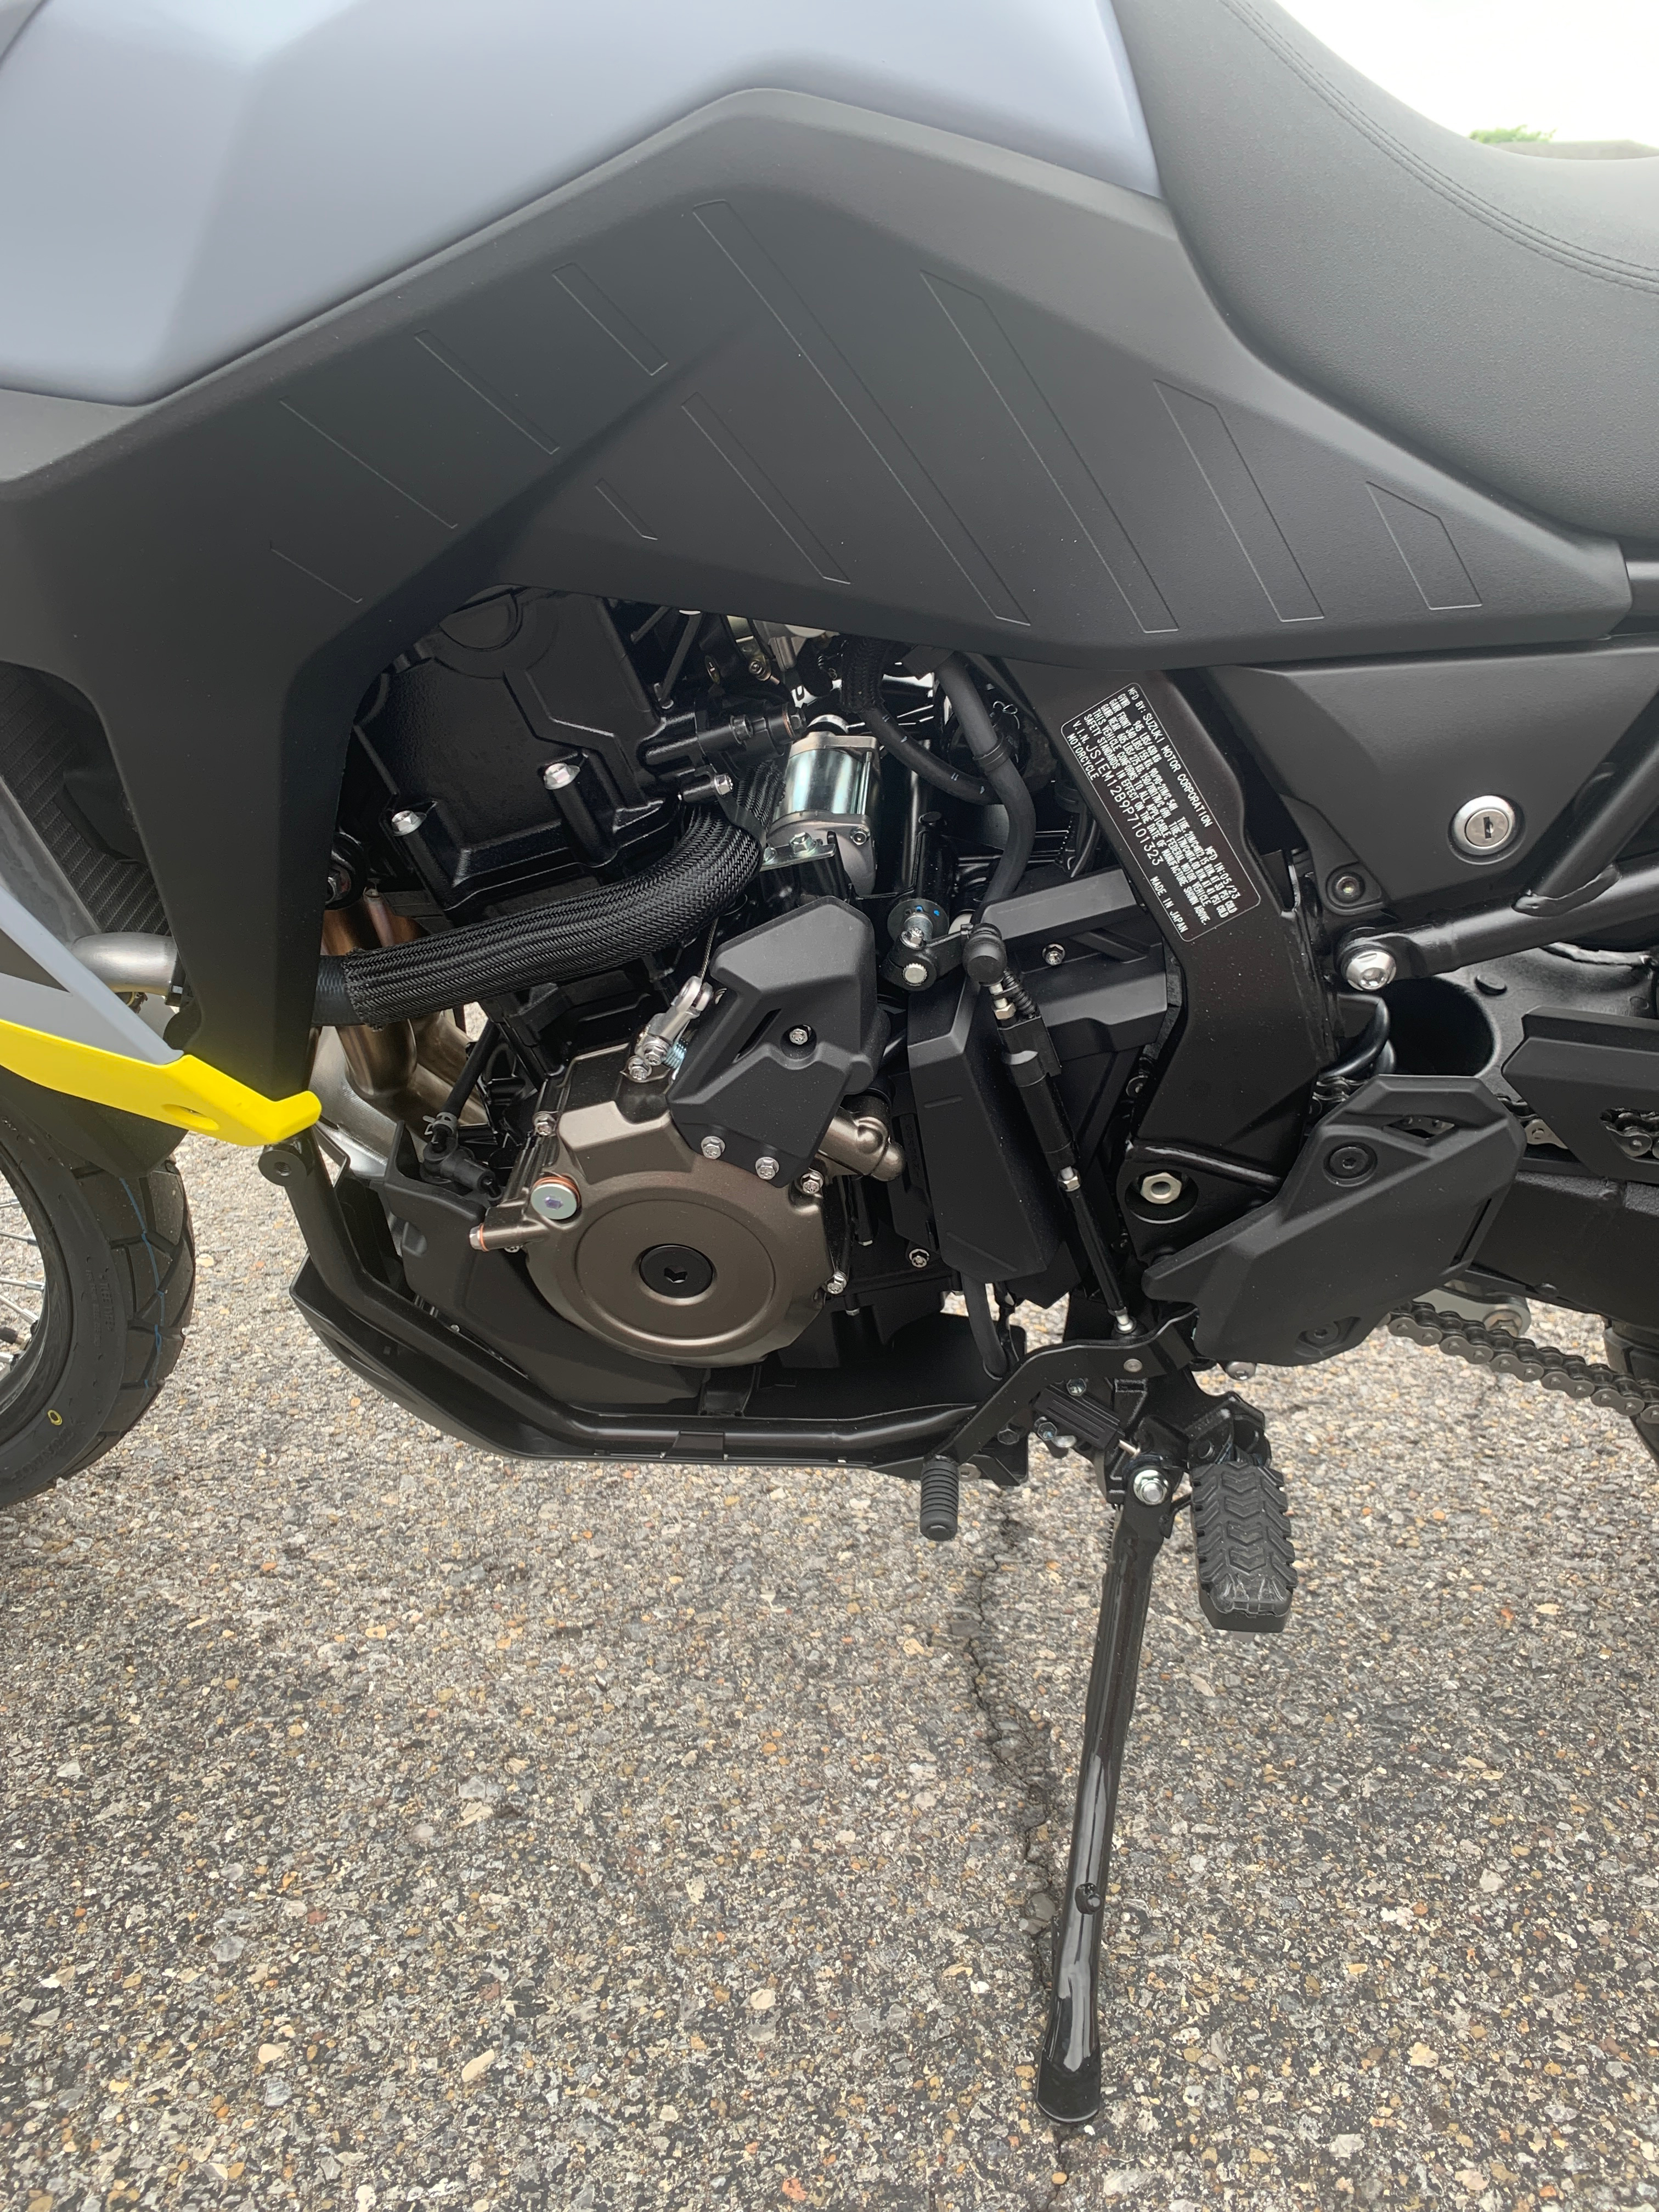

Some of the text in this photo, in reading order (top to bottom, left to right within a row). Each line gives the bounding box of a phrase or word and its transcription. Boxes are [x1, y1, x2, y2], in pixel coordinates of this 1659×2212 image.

[1084, 714, 1102, 736] SAFETY
[1116, 711, 1131, 729] FRONT
[1125, 726, 1137, 738] 340
[1132, 720, 1144, 731] 945
[1152, 753, 1162, 763] KG
[1066, 733, 1099, 780] MOTORCYCLE
[1097, 736, 1120, 769] STANDARDS
[1127, 687, 1212, 827] MFD BY: SUZUKI MOTOR CORPORATION
[1115, 769, 1126, 779] IN
[1120, 778, 1139, 800] EFFECT
[1086, 744, 1164, 865] JS1EM12B9P7101323
[1092, 708, 1211, 906] THIS VEHICLE CONFORMS TO ALL APPLICABLE FEDERAL MOTOR VEHICLE
[1134, 801, 1145, 811] ON
[1108, 716, 1121, 731] REAR
[1116, 732, 1128, 743] 605
[1201, 879, 1212, 888] AT
[1210, 894, 1221, 905] PSI
[1216, 904, 1228, 917] COLD
[1139, 810, 1152, 823] THE
[1147, 823, 1161, 839] DATE
[1204, 845, 1217, 860] MFD
[1161, 848, 1188, 887] MANUFACTURE
[1183, 886, 1199, 905] SHOWN
[1214, 882, 1224, 890] 33
[1218, 889, 1230, 900] PSI
[1150, 876, 1188, 933] MADE IN JAPAN
[1224, 900, 1237, 913] COLD
